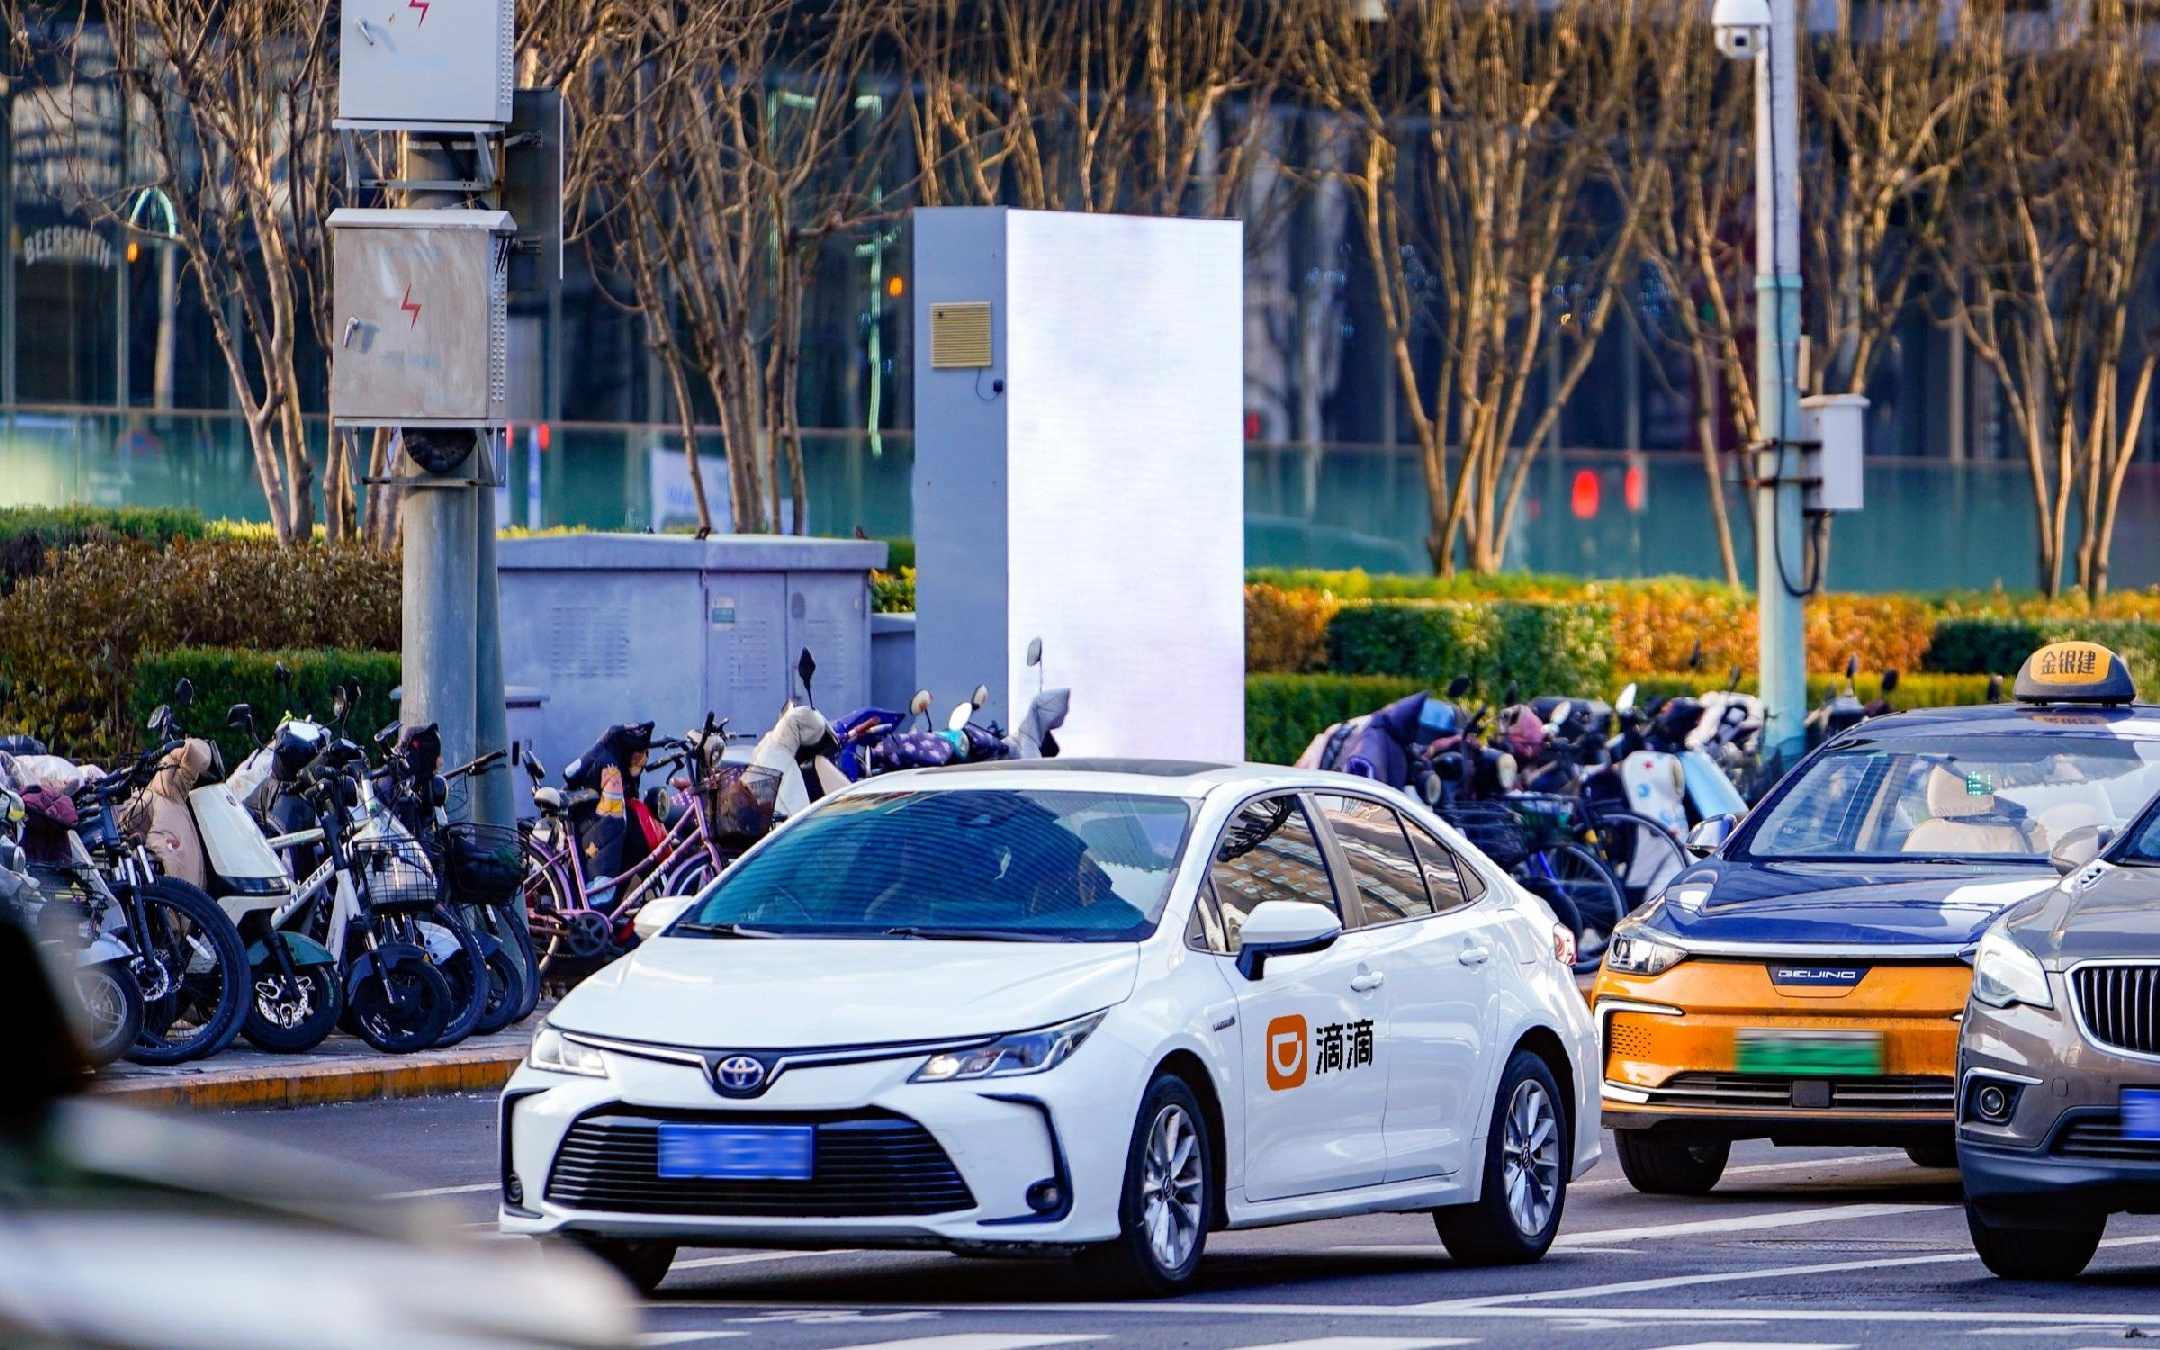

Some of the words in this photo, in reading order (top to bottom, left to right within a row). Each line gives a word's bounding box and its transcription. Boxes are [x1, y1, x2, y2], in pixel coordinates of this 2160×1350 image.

[24, 226, 111, 270] BEERSMITH
[2041, 650, 2096, 675] 金银建
[1778, 969, 1856, 979] BEIJING
[1316, 1019, 1374, 1075] 滴滴
